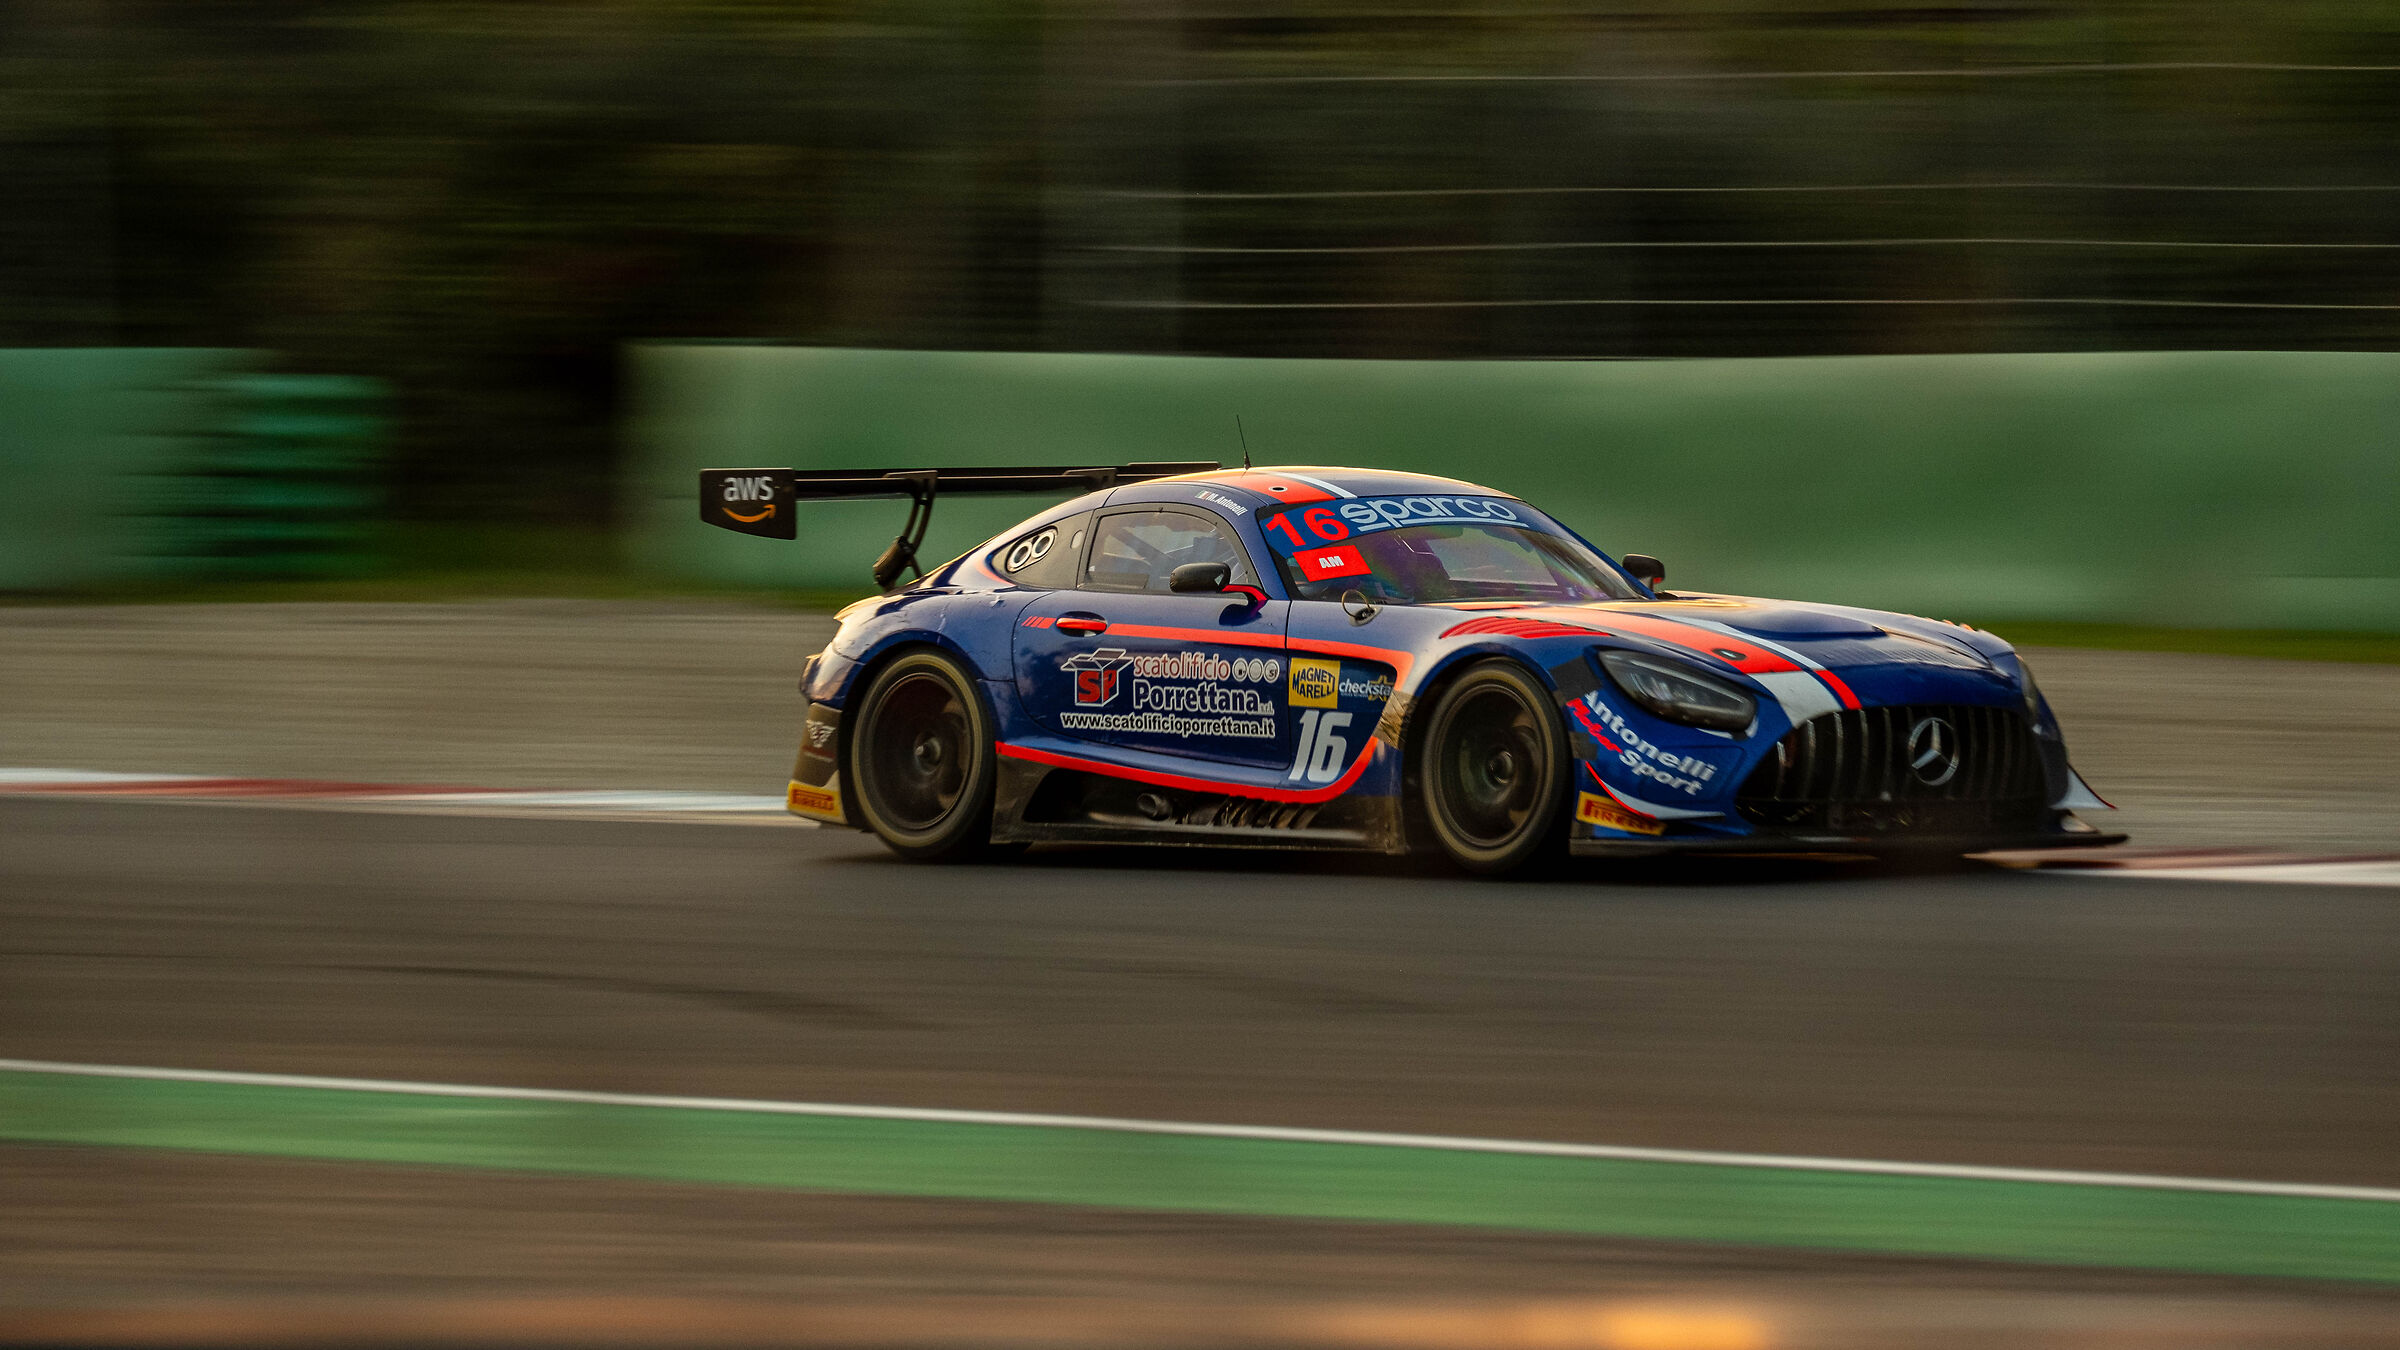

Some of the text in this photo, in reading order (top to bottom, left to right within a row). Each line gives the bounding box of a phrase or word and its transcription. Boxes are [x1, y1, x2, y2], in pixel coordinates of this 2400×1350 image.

[723, 475, 774, 502] aws
[1206, 492, 1248, 517] M.Antonelli
[1339, 497, 1517, 529] sparco
[1265, 507, 1350, 547] 16
[1318, 555, 1345, 569] AM
[1133, 652, 1231, 681] scatolificio
[1292, 667, 1336, 693] MAGNETI
[1077, 669, 1119, 703] SP
[1132, 679, 1261, 714] Porrettana
[1291, 673, 1336, 700] MARELLI
[1339, 678, 1393, 697] checksta
[1060, 711, 1276, 739] www.scatolificioporrettana.it
[1566, 697, 1624, 755] Motor
[1585, 690, 1718, 782] Antonelli
[1288, 709, 1353, 783] 16
[1618, 749, 1703, 796] Sport
